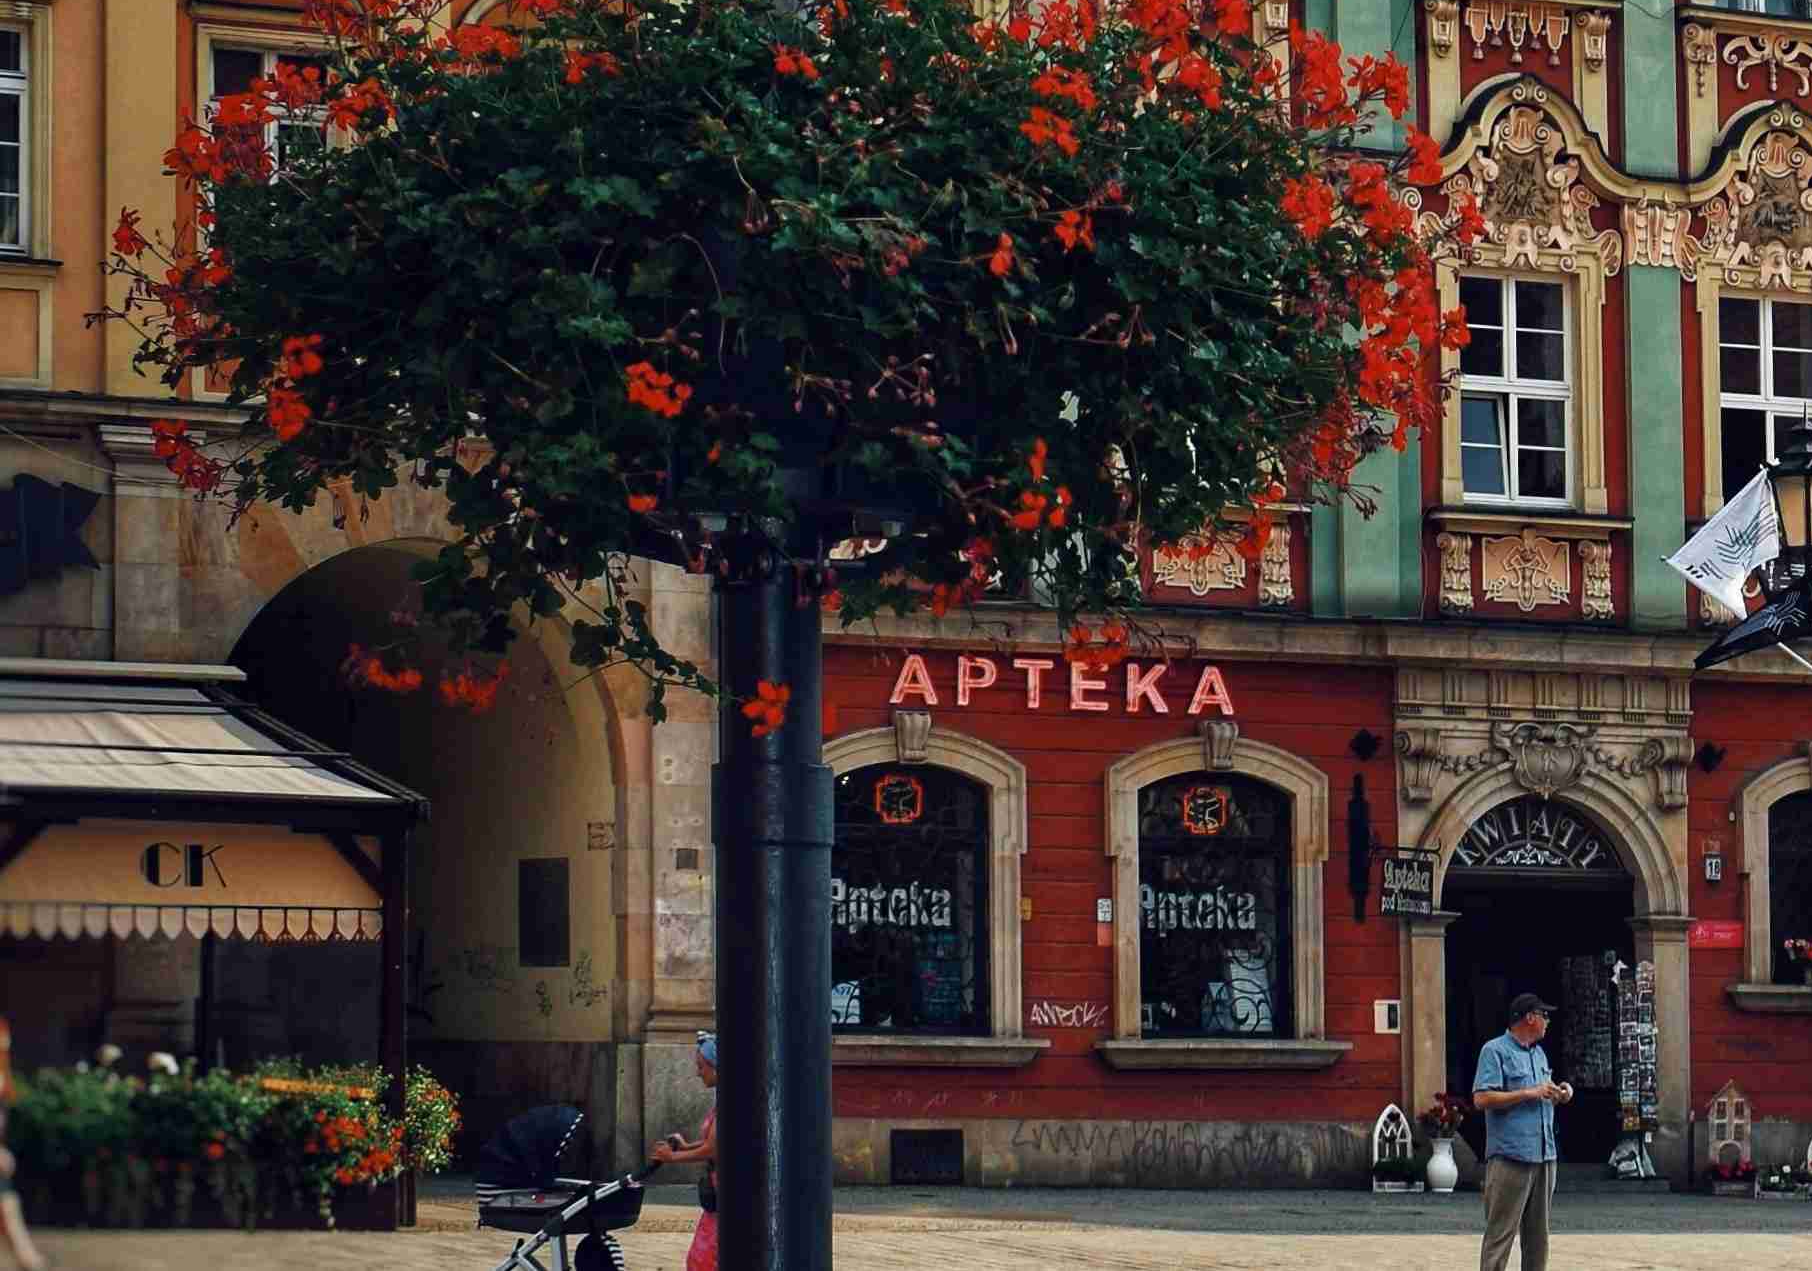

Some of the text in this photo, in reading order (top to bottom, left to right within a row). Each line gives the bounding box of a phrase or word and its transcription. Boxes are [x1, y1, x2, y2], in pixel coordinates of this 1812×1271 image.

[889, 654, 1233, 716] APTEKA
[140, 842, 227, 888] CK
[1456, 807, 1606, 869] KWIATY
